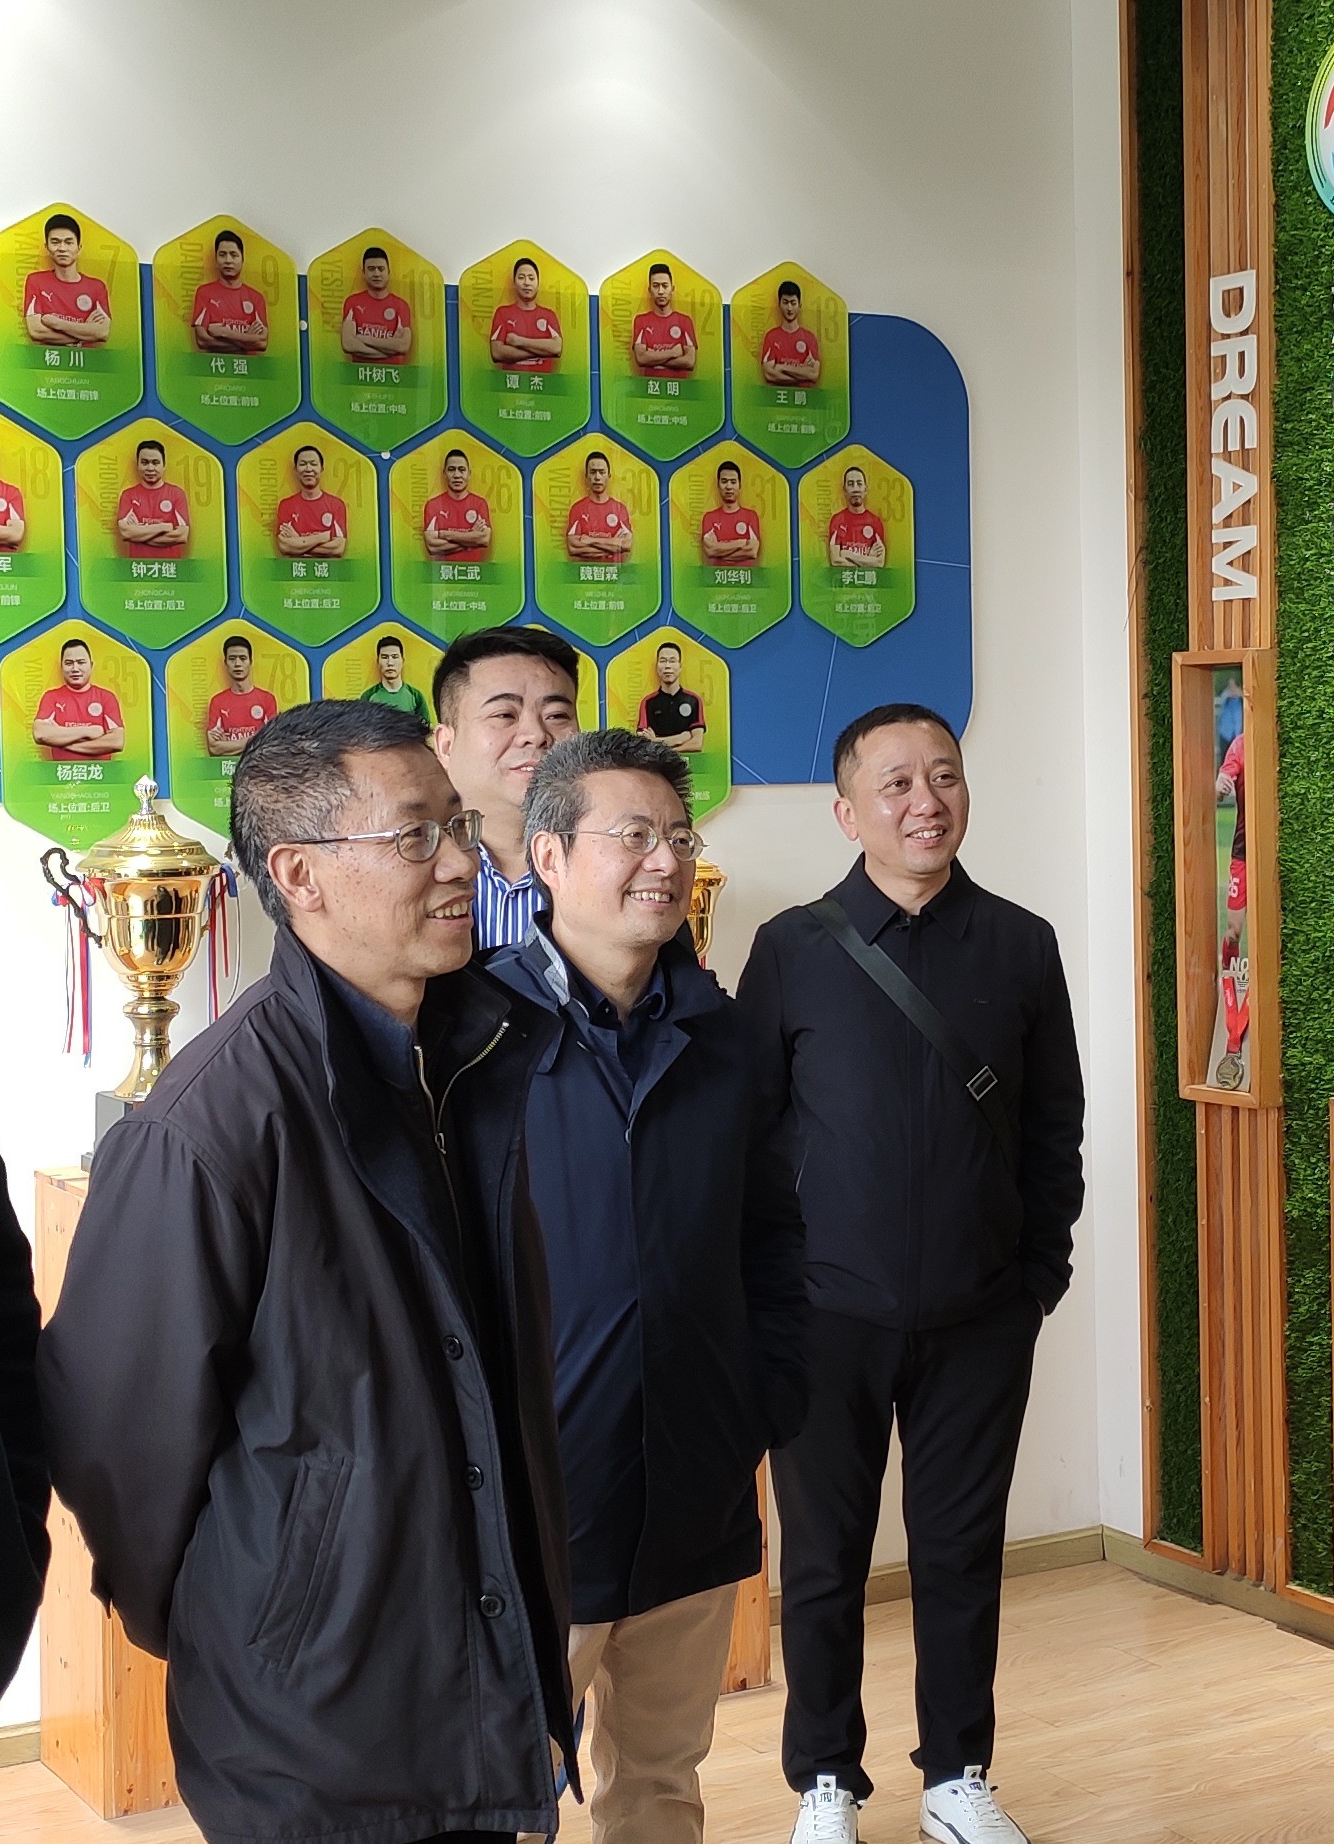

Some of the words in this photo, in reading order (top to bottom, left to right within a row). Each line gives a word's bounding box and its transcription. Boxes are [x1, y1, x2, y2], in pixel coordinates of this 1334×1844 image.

[45, 349, 84, 368] 杨川
[210, 358, 248, 375] 代强
[358, 367, 400, 383] 叶树飞
[351, 402, 407, 415] 场上位置:中场
[637, 414, 687, 426] 场上位置:中场
[1209, 269, 1259, 602] DREAM
[132, 562, 177, 578] 钟才继
[292, 562, 329, 578] 陈诚
[440, 564, 481, 580] 景仁武
[580, 566, 618, 582] 魏智霖
[841, 570, 877, 585] 李仁鹏
[124, 600, 185, 611] 场上位置:后卫
[283, 599, 340, 609] 场上位置:后卫
[432, 601, 486, 611] 场上位置:中场
[56, 764, 103, 781] 杨绍龙
[48, 802, 110, 813] 场上位置:后卫
